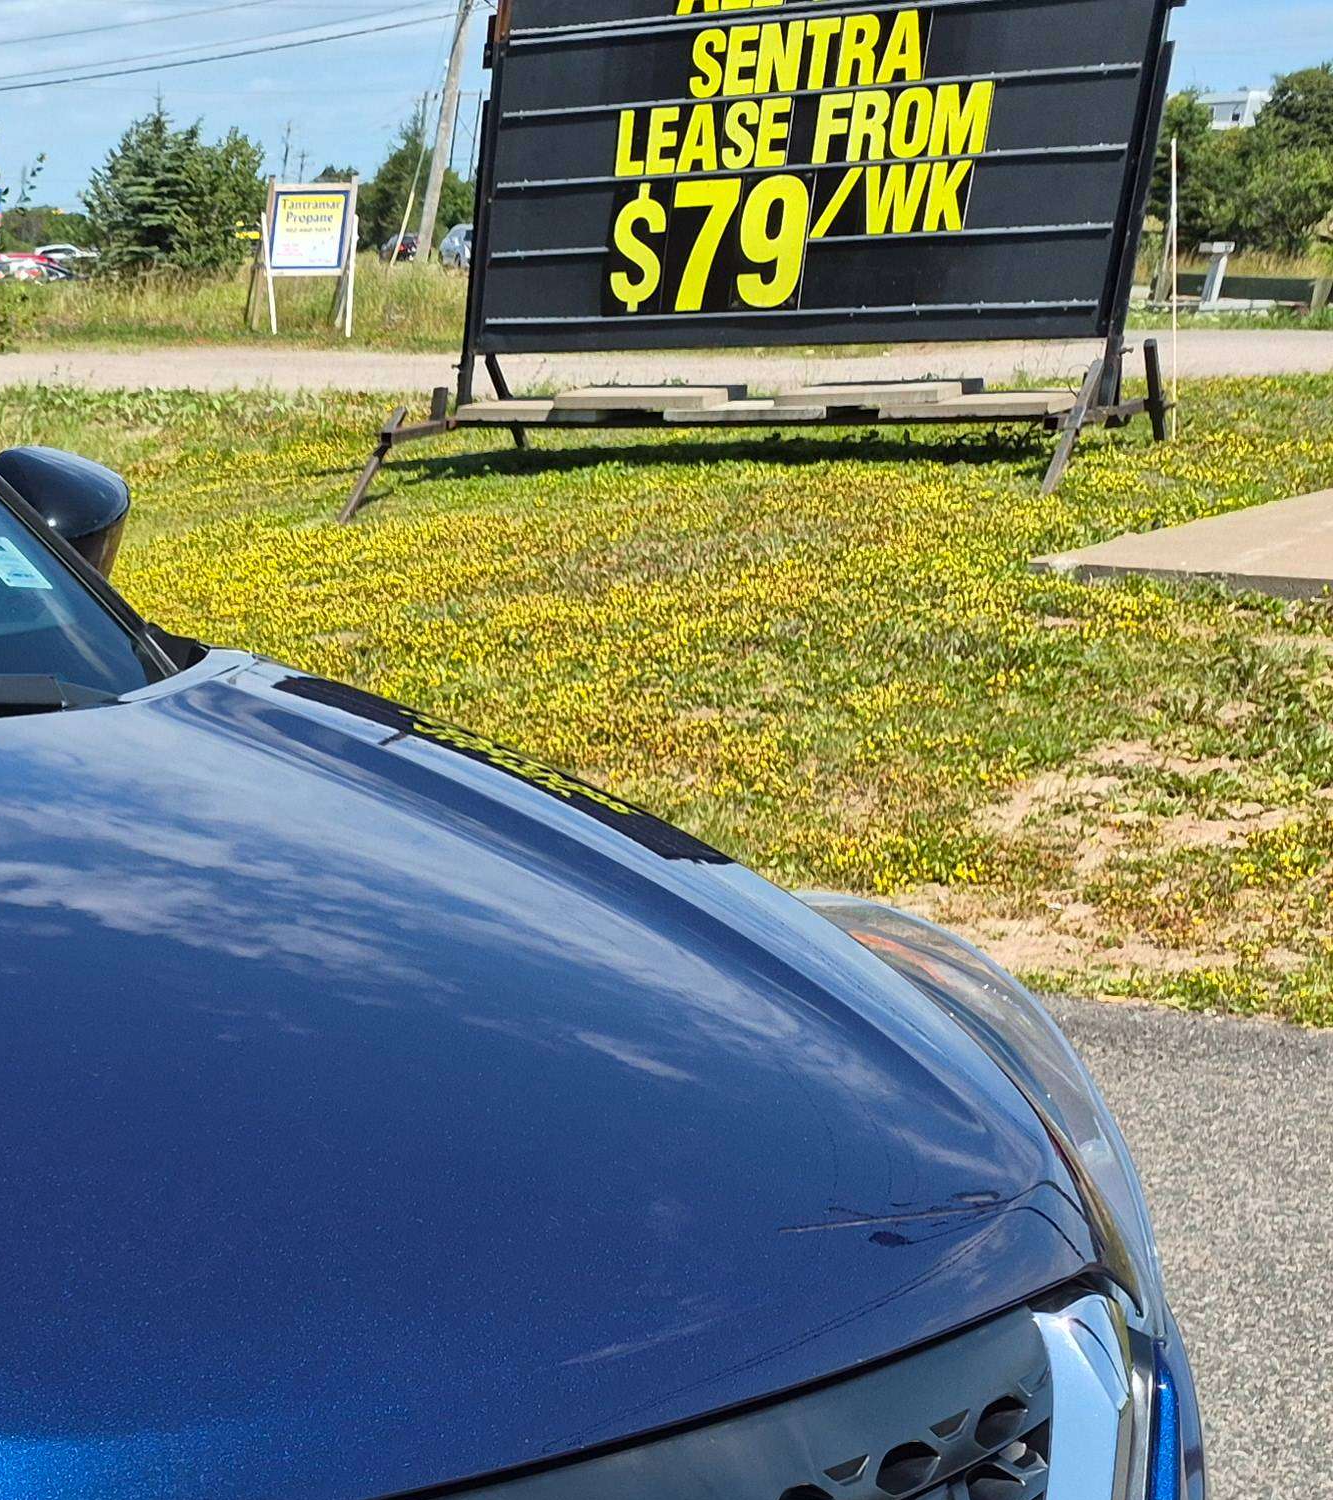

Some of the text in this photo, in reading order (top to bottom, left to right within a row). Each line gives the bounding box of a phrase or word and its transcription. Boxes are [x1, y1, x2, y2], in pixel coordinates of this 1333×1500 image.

[690, 9, 922, 99] SENTRA
[614, 80, 994, 177] LEASE FROM
[286, 210, 334, 224] Propane
